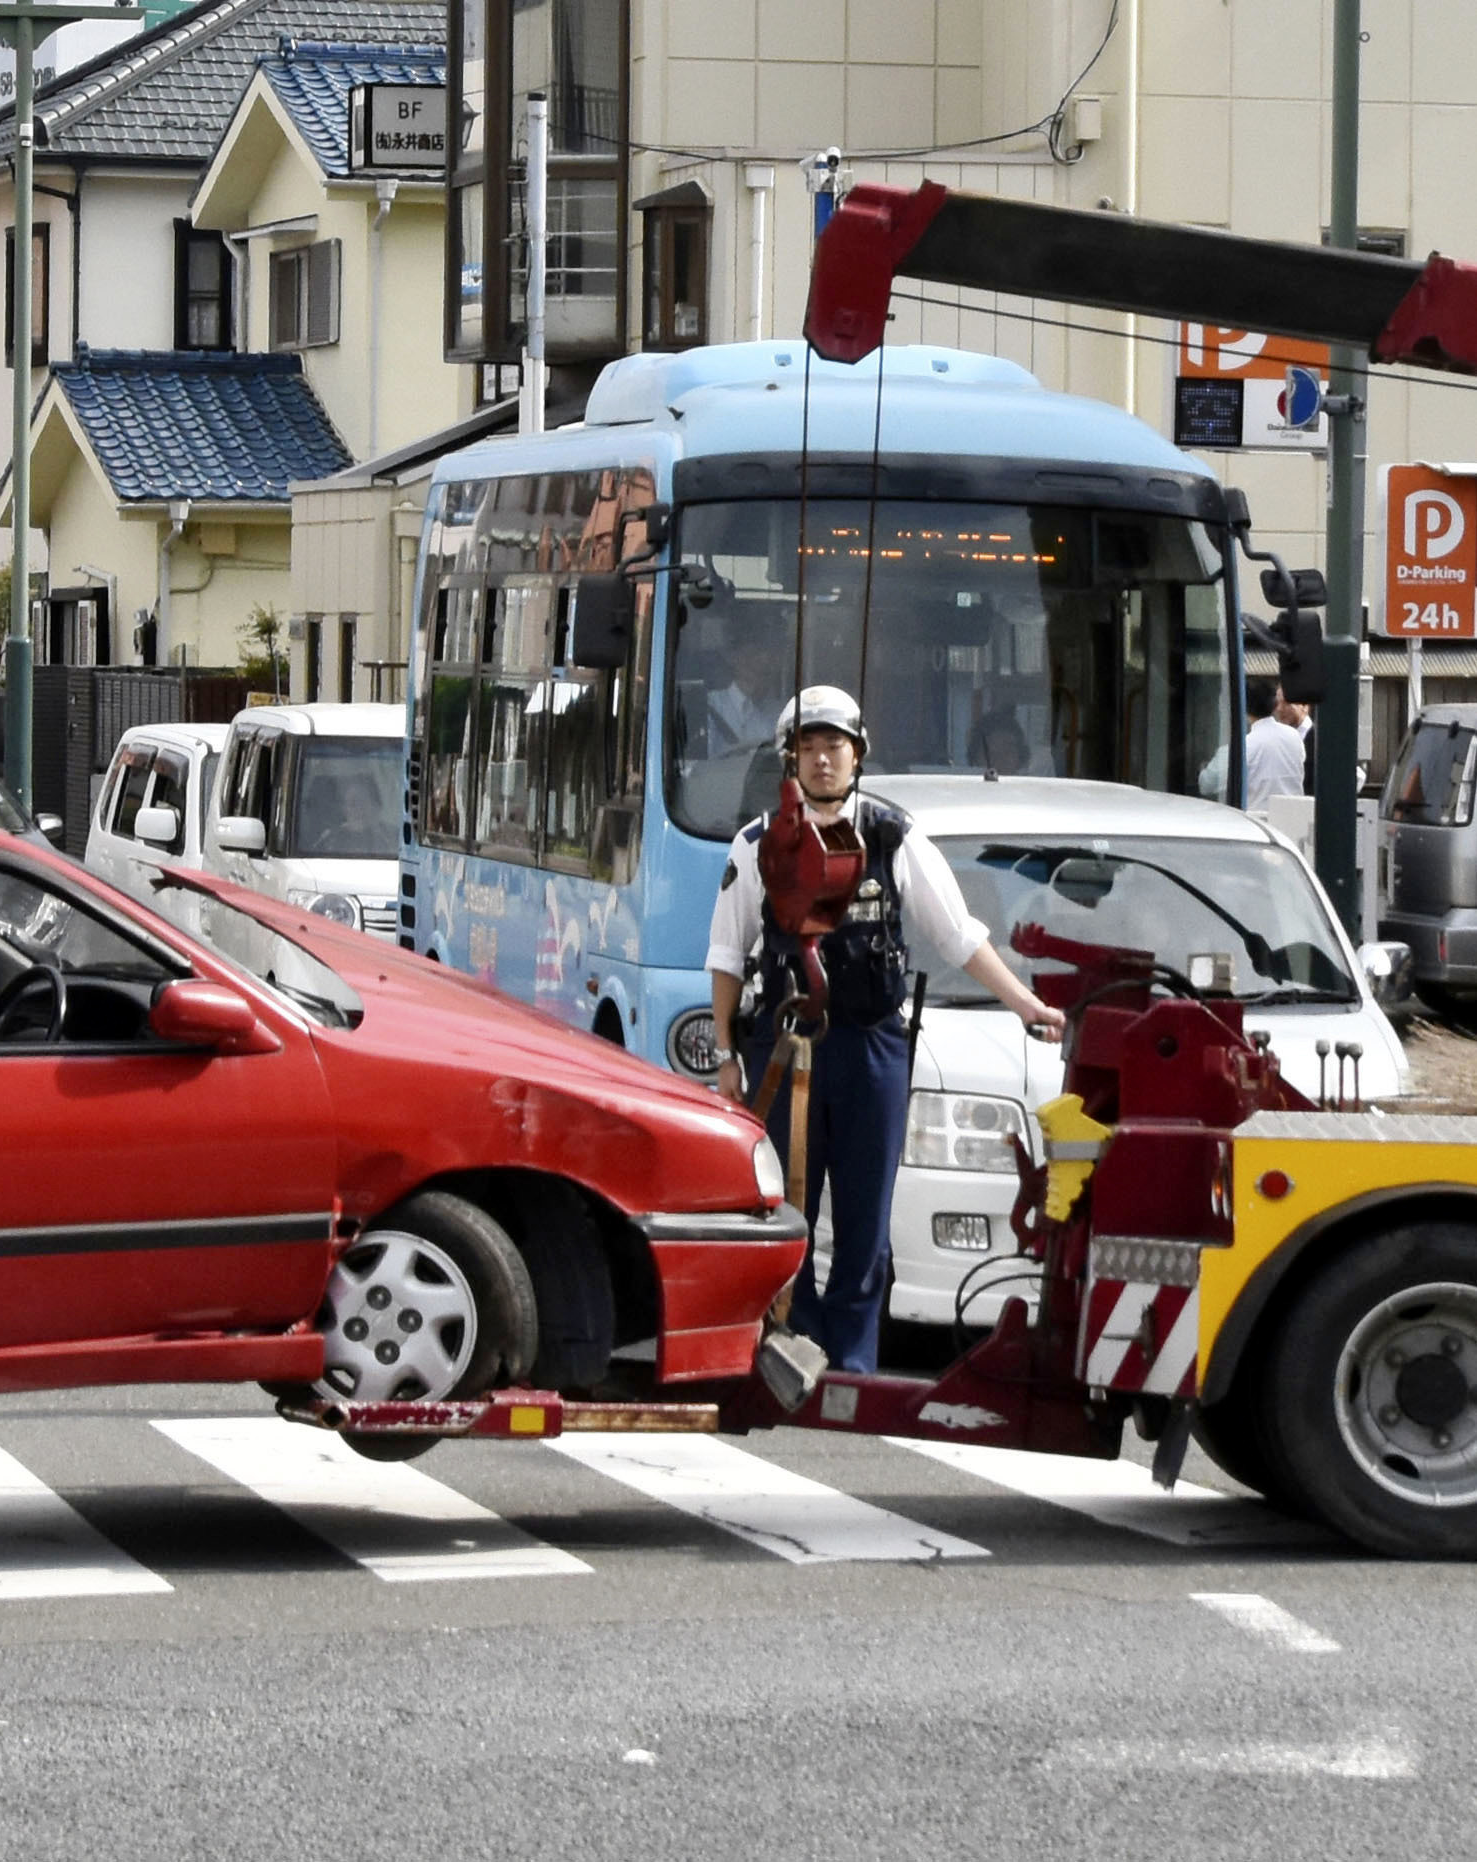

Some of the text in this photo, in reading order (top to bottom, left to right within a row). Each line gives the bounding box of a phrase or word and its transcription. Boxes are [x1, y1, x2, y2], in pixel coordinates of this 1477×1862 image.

[398, 101, 422, 119] BF
[1396, 564, 1467, 583] D-Parking
[1401, 601, 1460, 630] 24h
